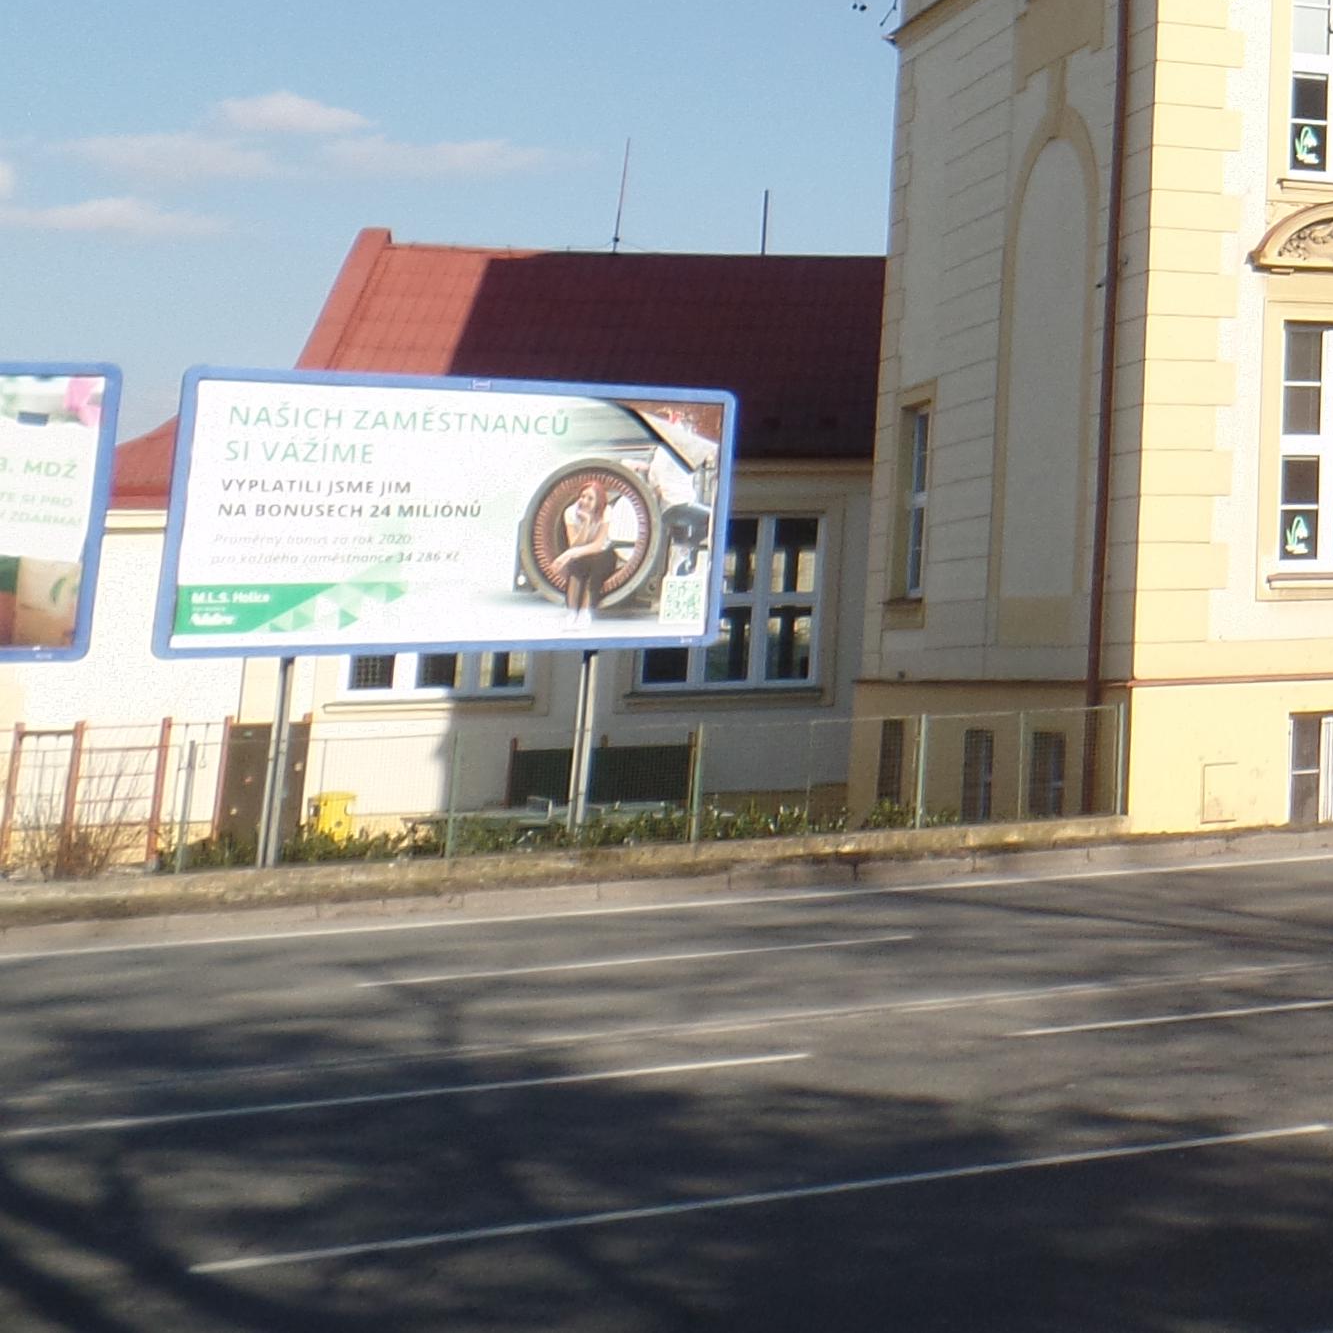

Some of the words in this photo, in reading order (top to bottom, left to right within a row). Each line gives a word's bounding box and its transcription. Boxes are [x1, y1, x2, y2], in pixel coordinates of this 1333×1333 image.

[229, 401, 343, 429] NAŠICH
[353, 405, 570, 436] ZAMĚSTNANCŮ
[225, 440, 249, 462] SI
[262, 436, 375, 464] VÁŽÍME
[23, 459, 78, 479] MDŽ
[221, 478, 322, 493] VYPLATILI
[327, 480, 375, 497] JSME
[379, 480, 412, 497] JIM
[217, 503, 247, 517] NA
[255, 503, 364, 518] BONUSECH
[369, 504, 392, 518] 24
[287, 534, 329, 545] bonus
[332, 536, 349, 545] za
[352, 534, 374, 545] rok
[396, 551, 413, 564] 34
